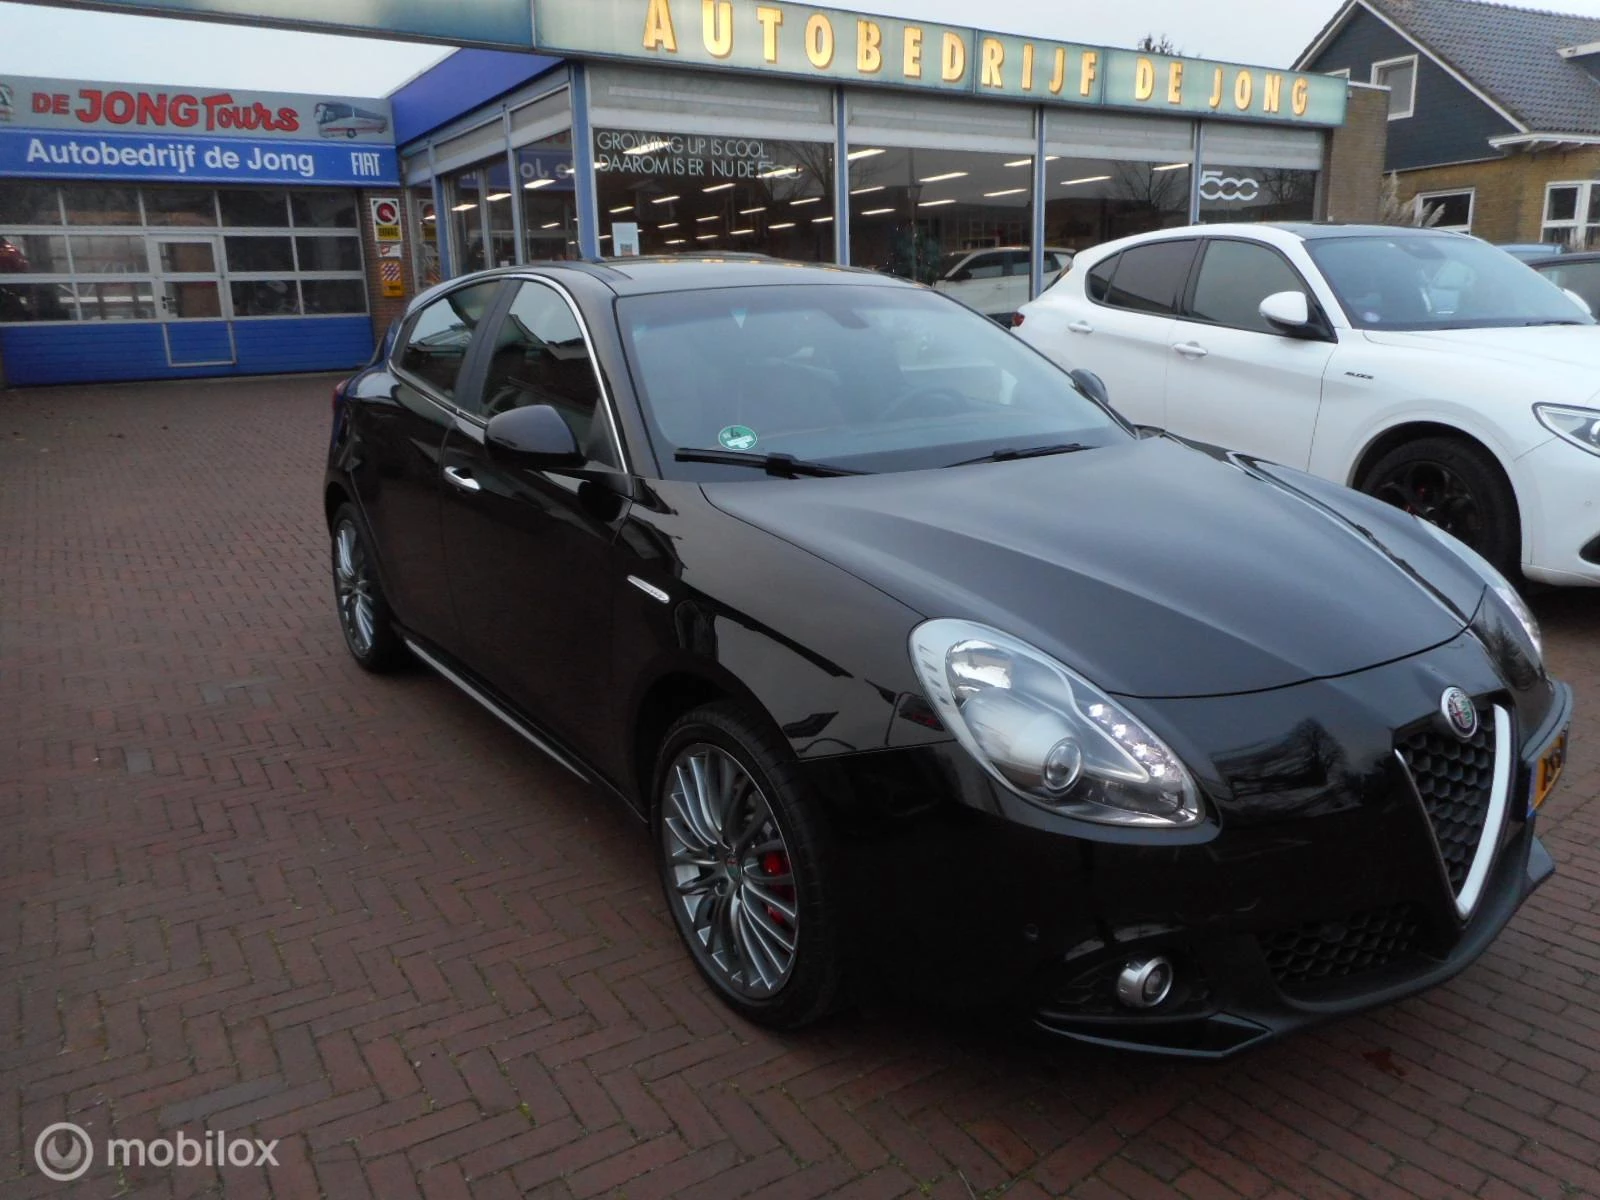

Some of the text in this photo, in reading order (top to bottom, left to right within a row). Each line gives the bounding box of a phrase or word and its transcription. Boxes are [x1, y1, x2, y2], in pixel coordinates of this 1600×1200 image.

[642, 0, 1308, 116] AUTOBEDRIJF DE JONG
[32, 89, 300, 132] DE JONG Tours
[27, 138, 381, 177] Autobedrijf de Jong FIAT
[597, 132, 768, 158] GROWING UP IS COOL
[598, 153, 670, 175] DAAROM
[673, 156, 685, 176] IS
[688, 158, 705, 176] ER
[711, 160, 734, 177] NU
[737, 161, 755, 178] DE
[1199, 170, 1260, 201] 500
